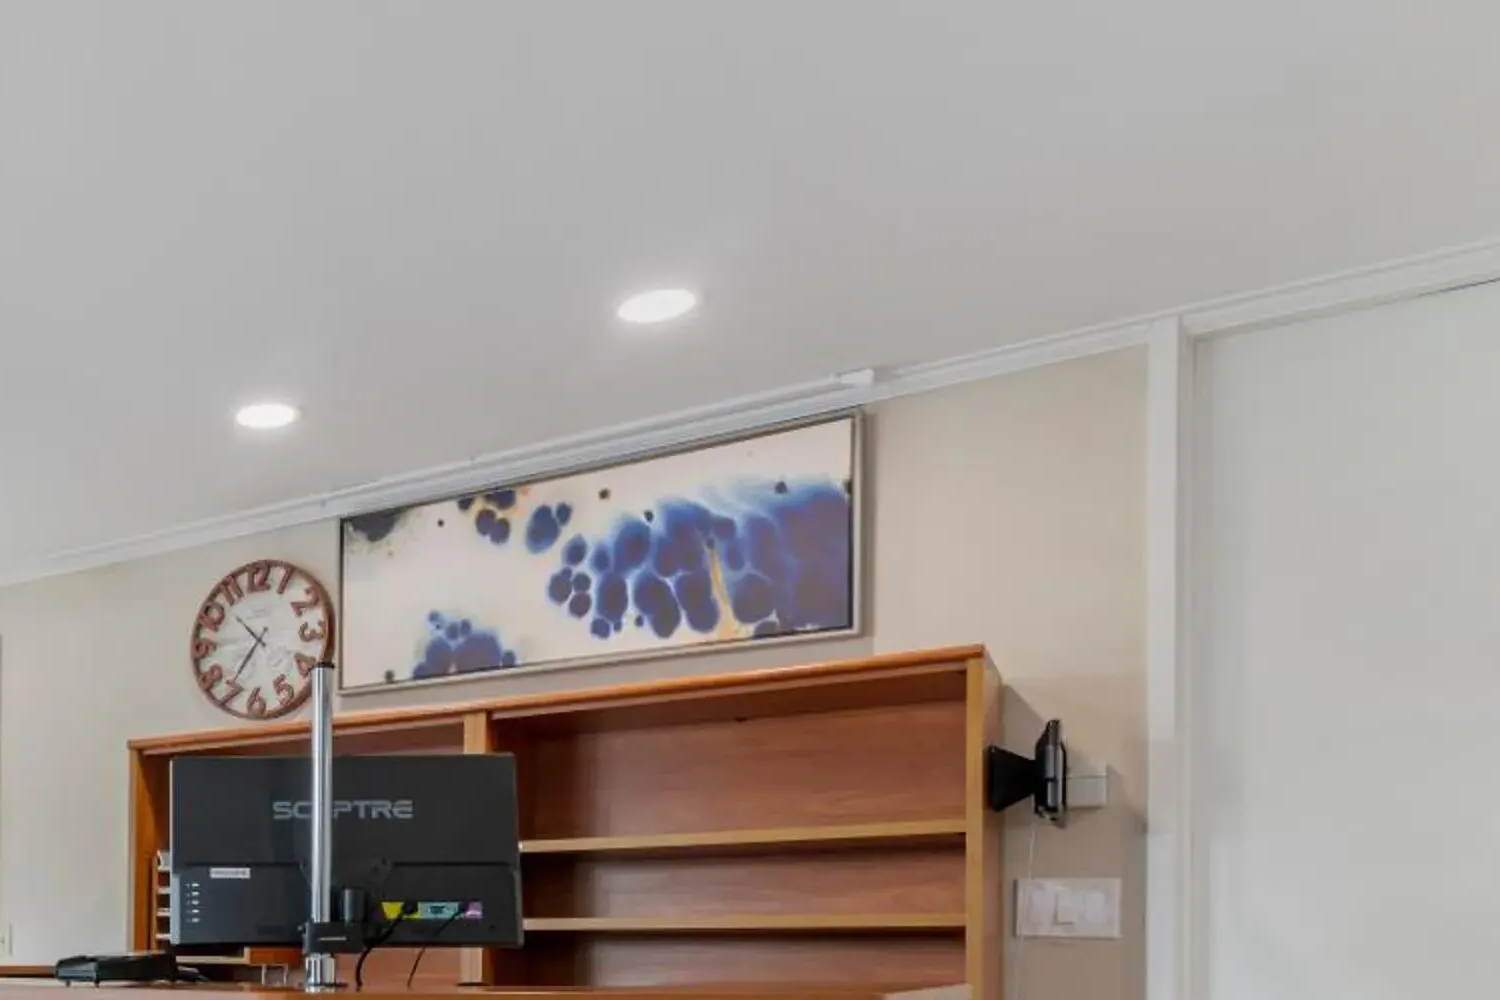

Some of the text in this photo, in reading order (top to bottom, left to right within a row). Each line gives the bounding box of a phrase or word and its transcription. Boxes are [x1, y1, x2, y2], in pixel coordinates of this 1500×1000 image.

[220, 575, 244, 606] 11
[248, 561, 271, 593] 12
[277, 565, 296, 594] 1
[290, 585, 319, 616] 2
[199, 602, 225, 632] 10
[299, 621, 325, 642] 3
[199, 664, 223, 690] 8
[294, 652, 317, 678] 4
[220, 679, 244, 707] 7
[247, 686, 266, 716] 6
[273, 674, 294, 706] 5
[272, 800, 414, 820] SCPTRE
